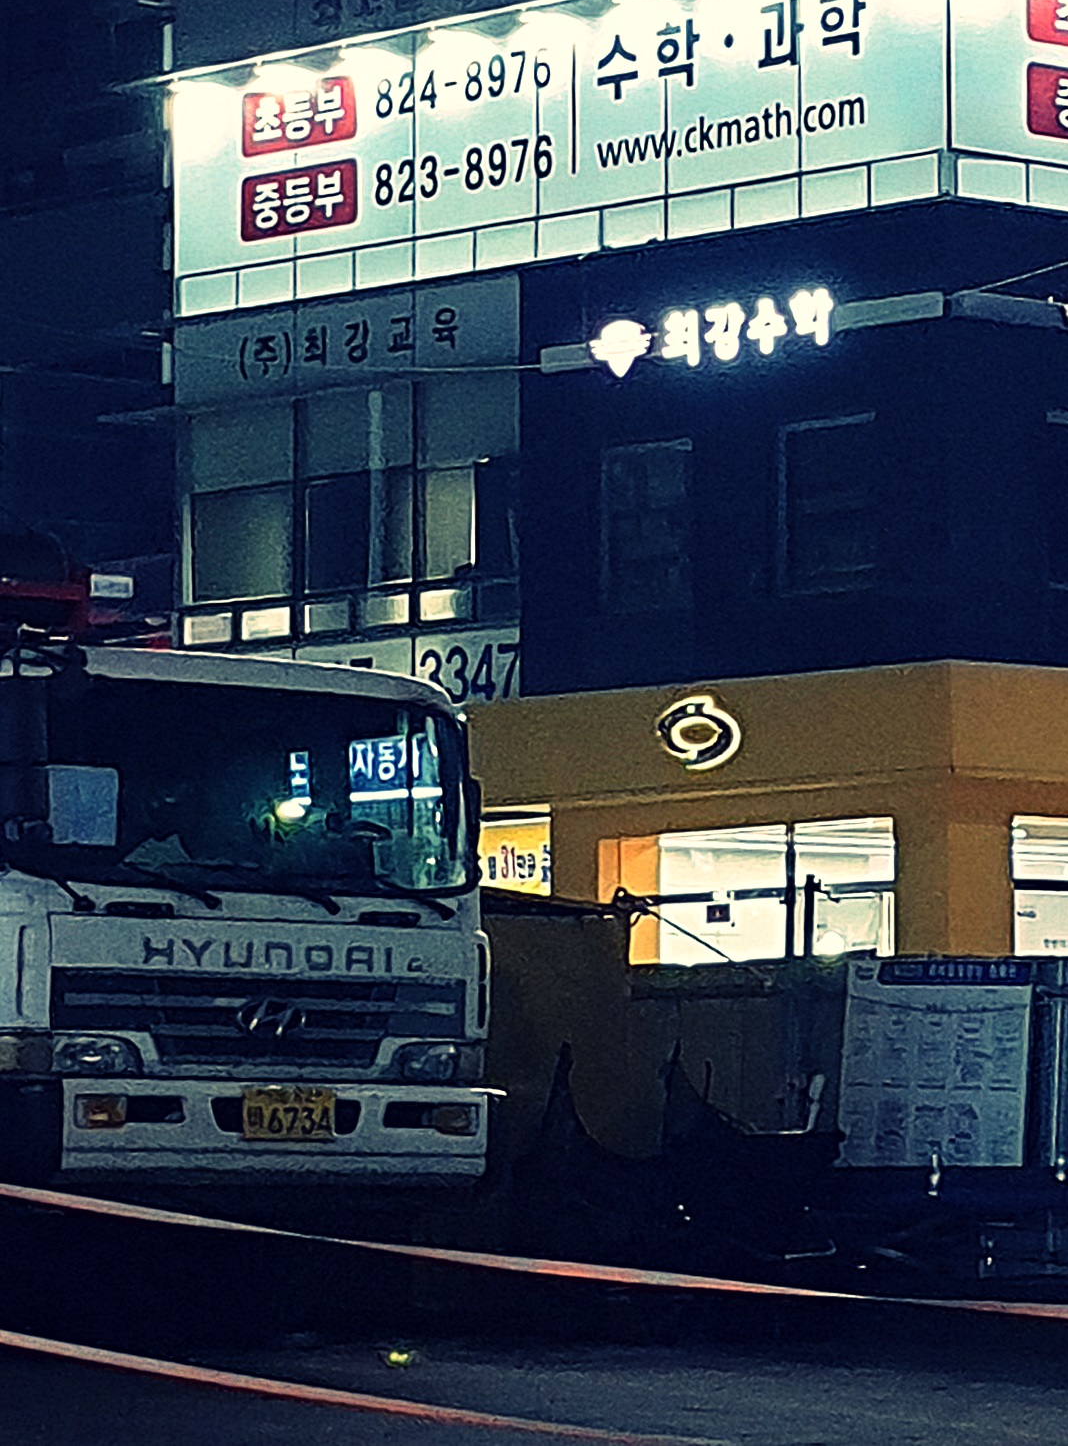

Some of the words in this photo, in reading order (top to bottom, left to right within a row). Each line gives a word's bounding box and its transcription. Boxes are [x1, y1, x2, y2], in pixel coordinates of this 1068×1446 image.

[252, 84, 347, 143] 초등부
[375, 48, 551, 118] 824-8976
[252, 170, 347, 229] 중등부
[375, 134, 553, 207] 823-8976
[597, 94, 866, 170] www.ckmath.com
[662, 288, 836, 368] 최강수학
[142, 936, 395, 973] HYUNDAI
